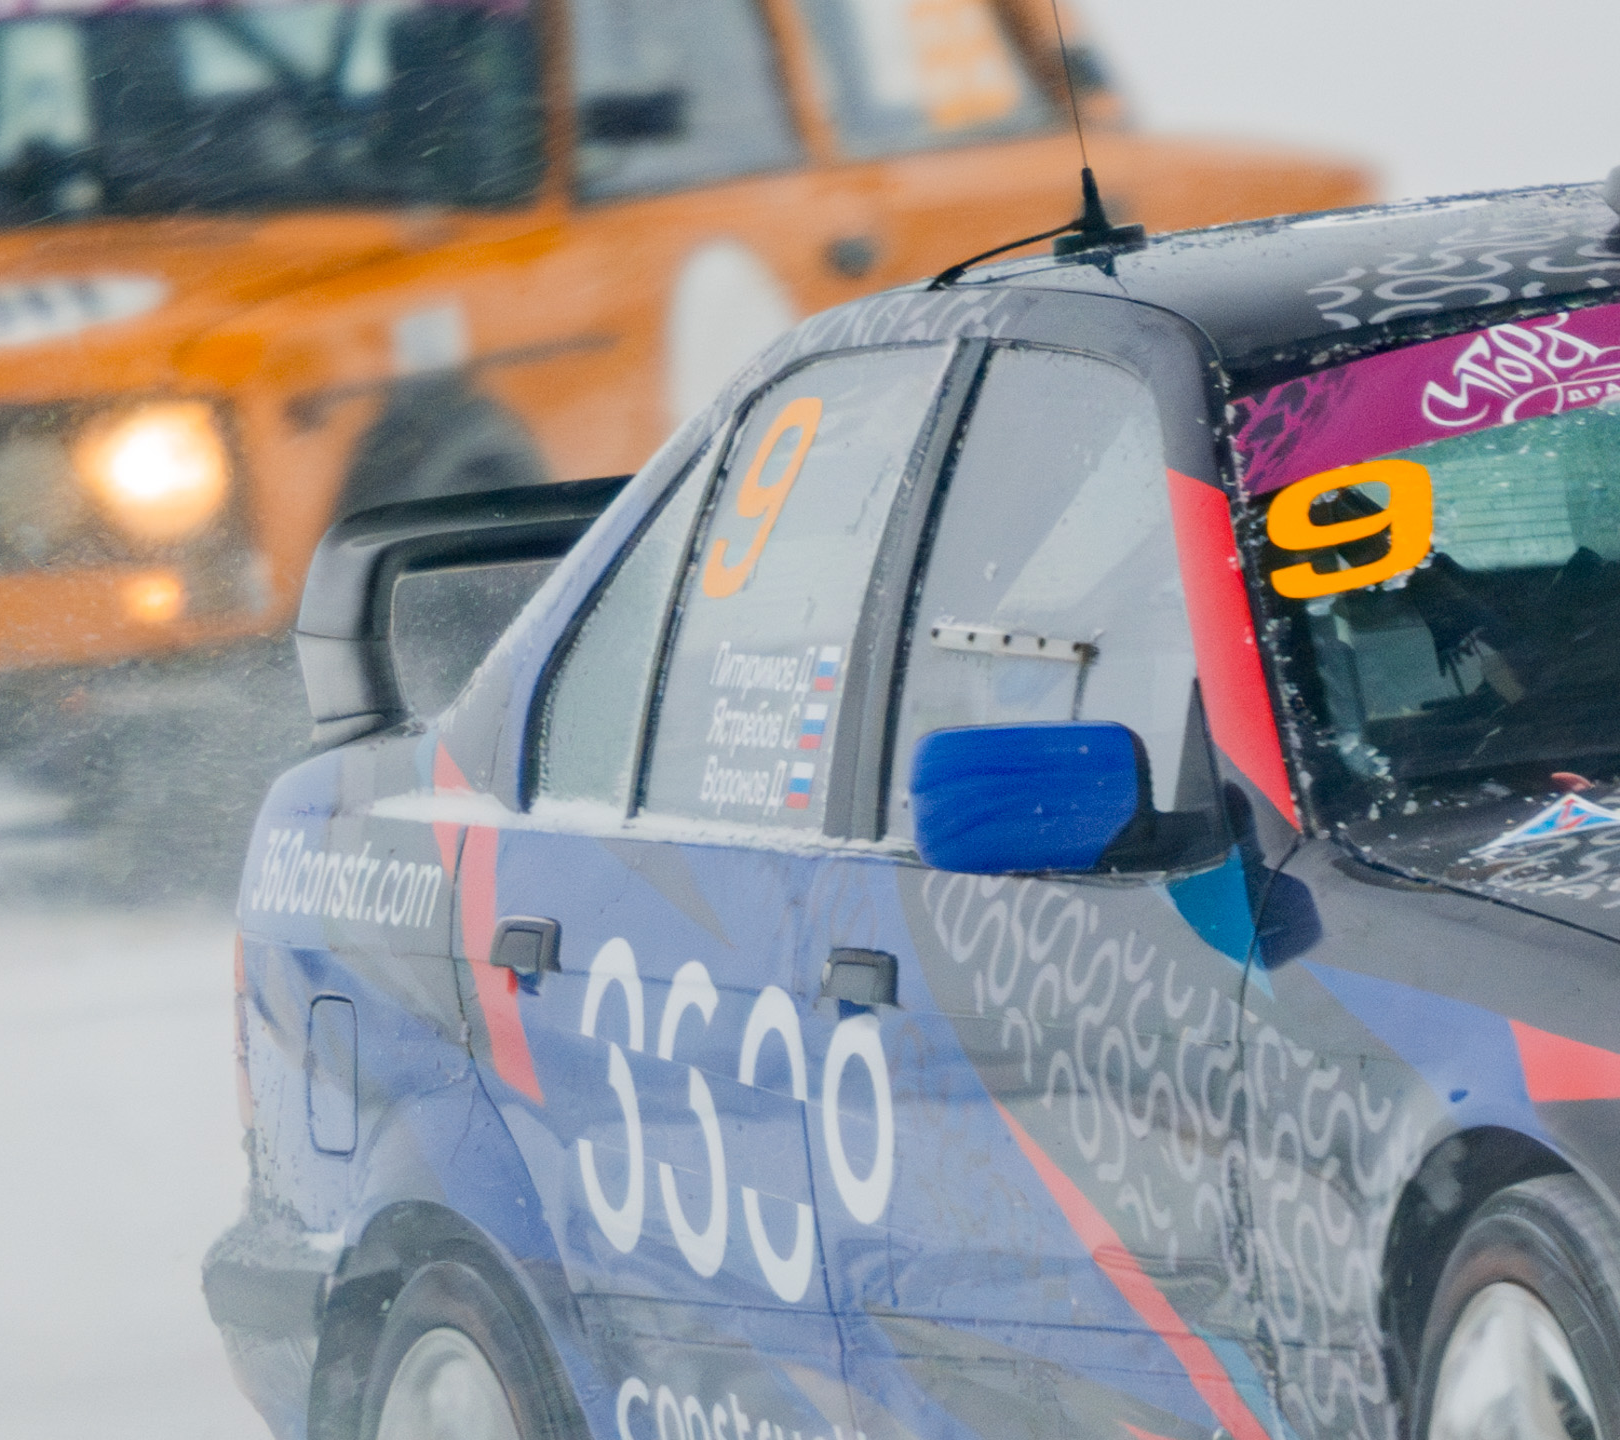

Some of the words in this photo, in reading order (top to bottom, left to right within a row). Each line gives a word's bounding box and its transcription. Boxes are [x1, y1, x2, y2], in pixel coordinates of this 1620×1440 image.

[702, 397, 823, 598] 9
[1266, 458, 1433, 599] 9
[252, 828, 442, 928] 360constr.com
